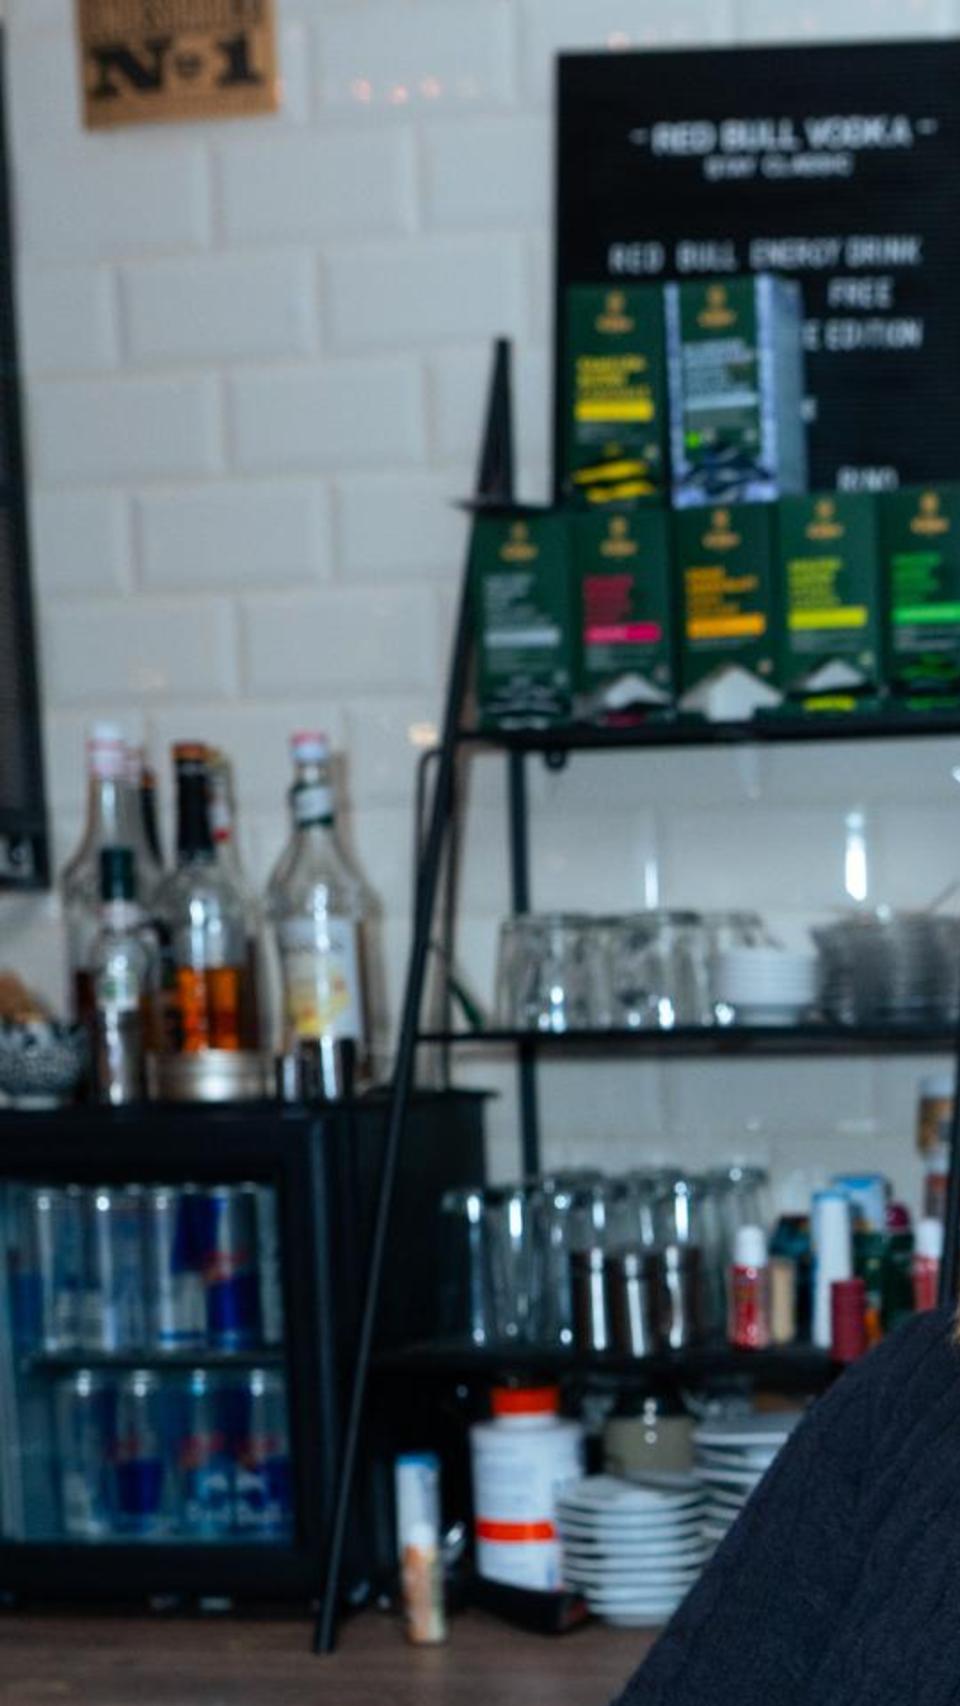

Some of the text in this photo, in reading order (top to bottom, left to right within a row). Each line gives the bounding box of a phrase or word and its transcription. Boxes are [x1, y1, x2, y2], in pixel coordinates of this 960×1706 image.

[650, 113, 914, 156] RED BULL VODKA
